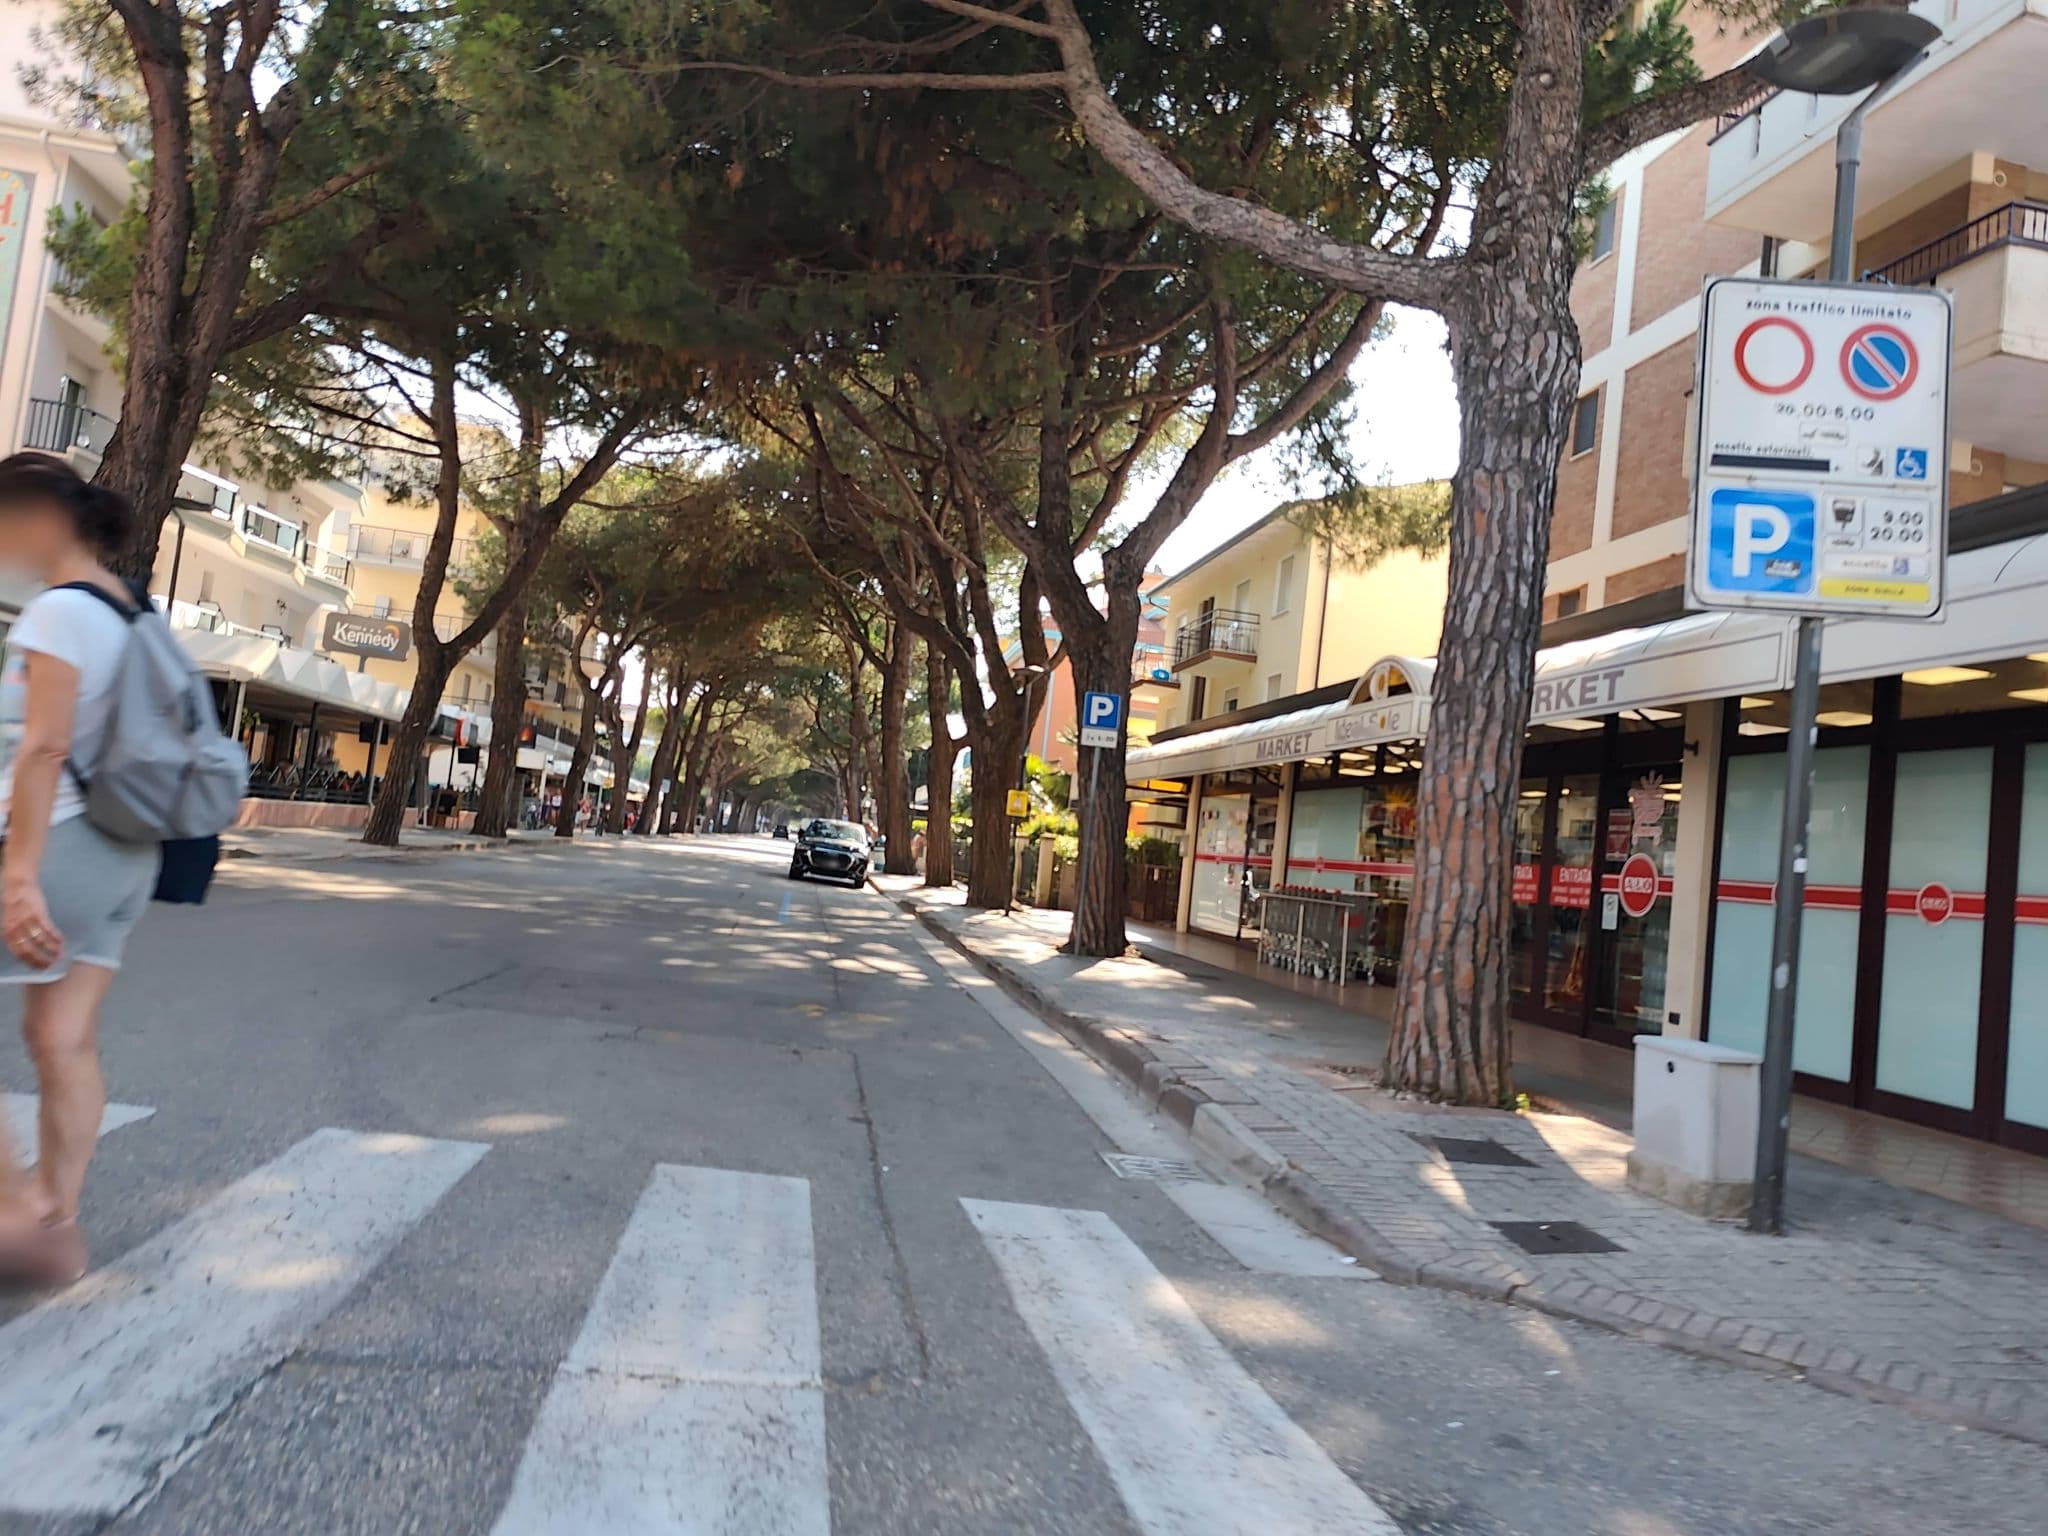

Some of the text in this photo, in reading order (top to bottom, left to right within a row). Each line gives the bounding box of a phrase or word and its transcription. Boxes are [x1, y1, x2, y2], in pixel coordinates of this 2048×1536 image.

[1746, 299, 1780, 311] zona
[1787, 300, 1845, 315] traffico
[1732, 503, 1791, 577] P
[332, 621, 399, 652] Kennedy
[1535, 669, 1624, 713] RKET
[1090, 695, 1114, 724] P
[1256, 733, 1312, 760] MARKET
